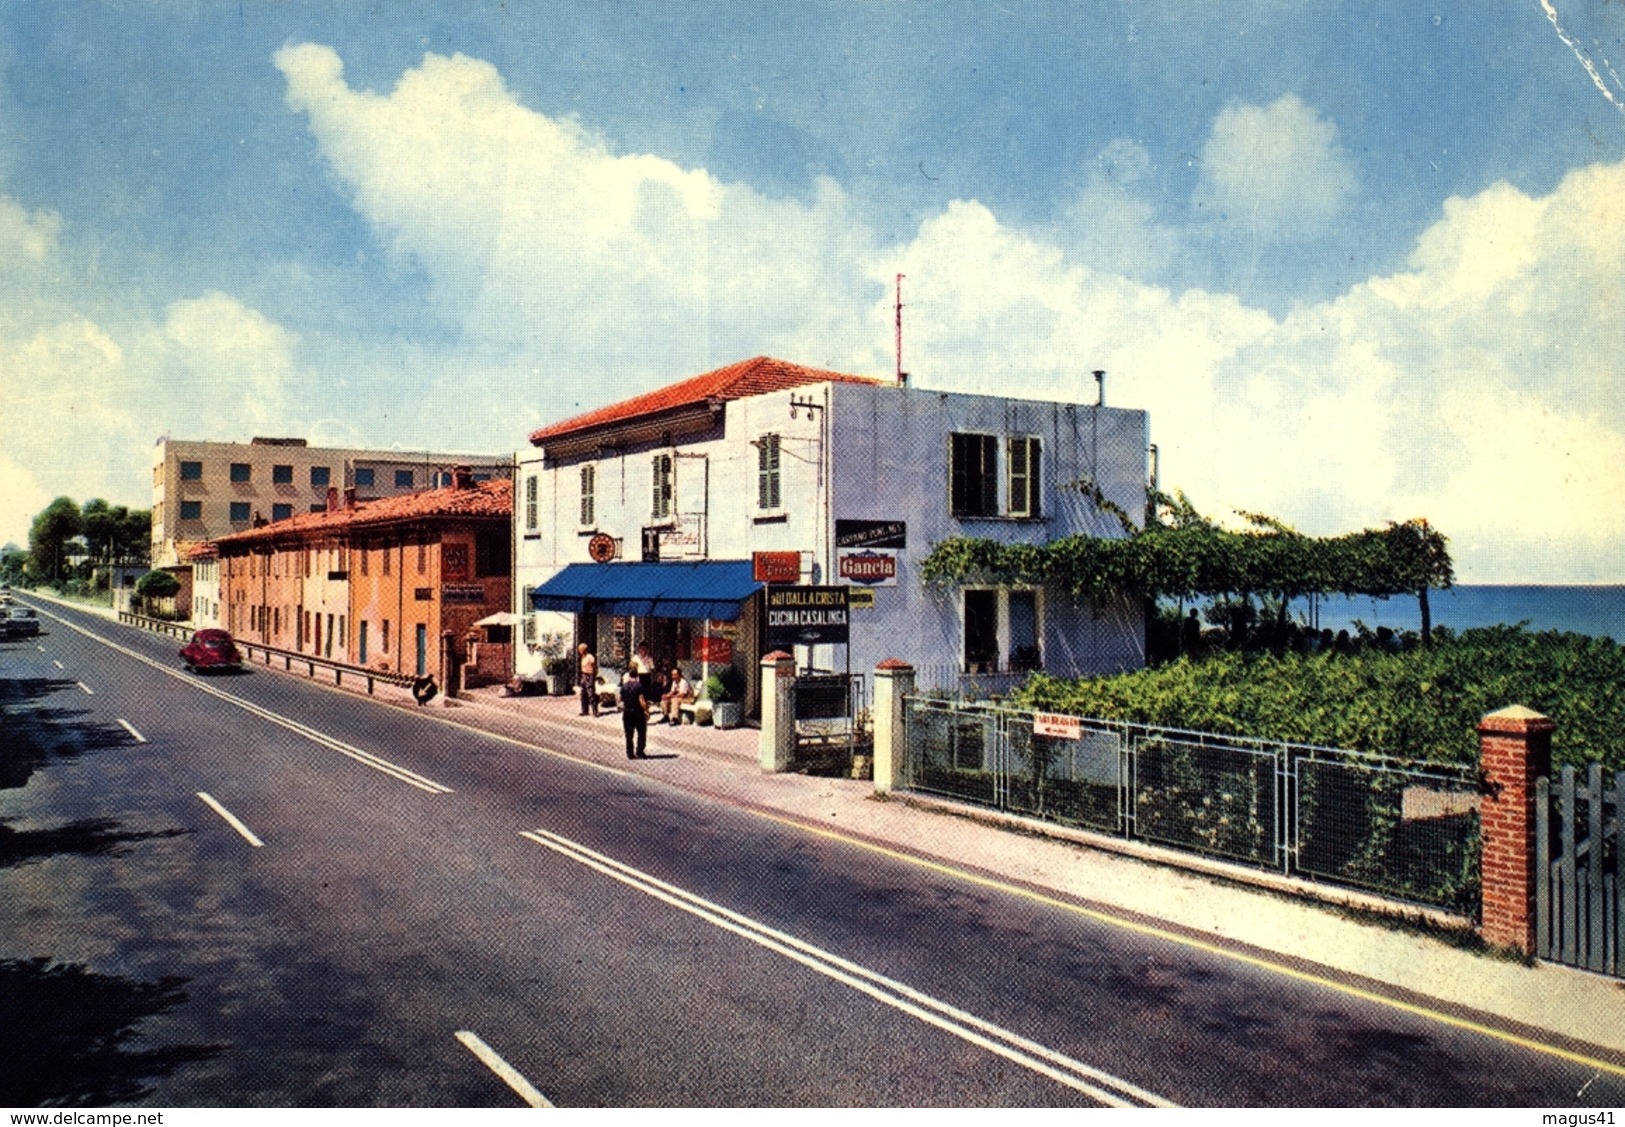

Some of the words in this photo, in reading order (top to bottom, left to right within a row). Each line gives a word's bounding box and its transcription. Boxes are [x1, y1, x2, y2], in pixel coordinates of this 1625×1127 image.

[842, 559, 893, 575] Gancia
[786, 591, 815, 605] DALLA
[769, 609, 799, 626] CUCINA
[800, 609, 847, 626] CASALINGA
